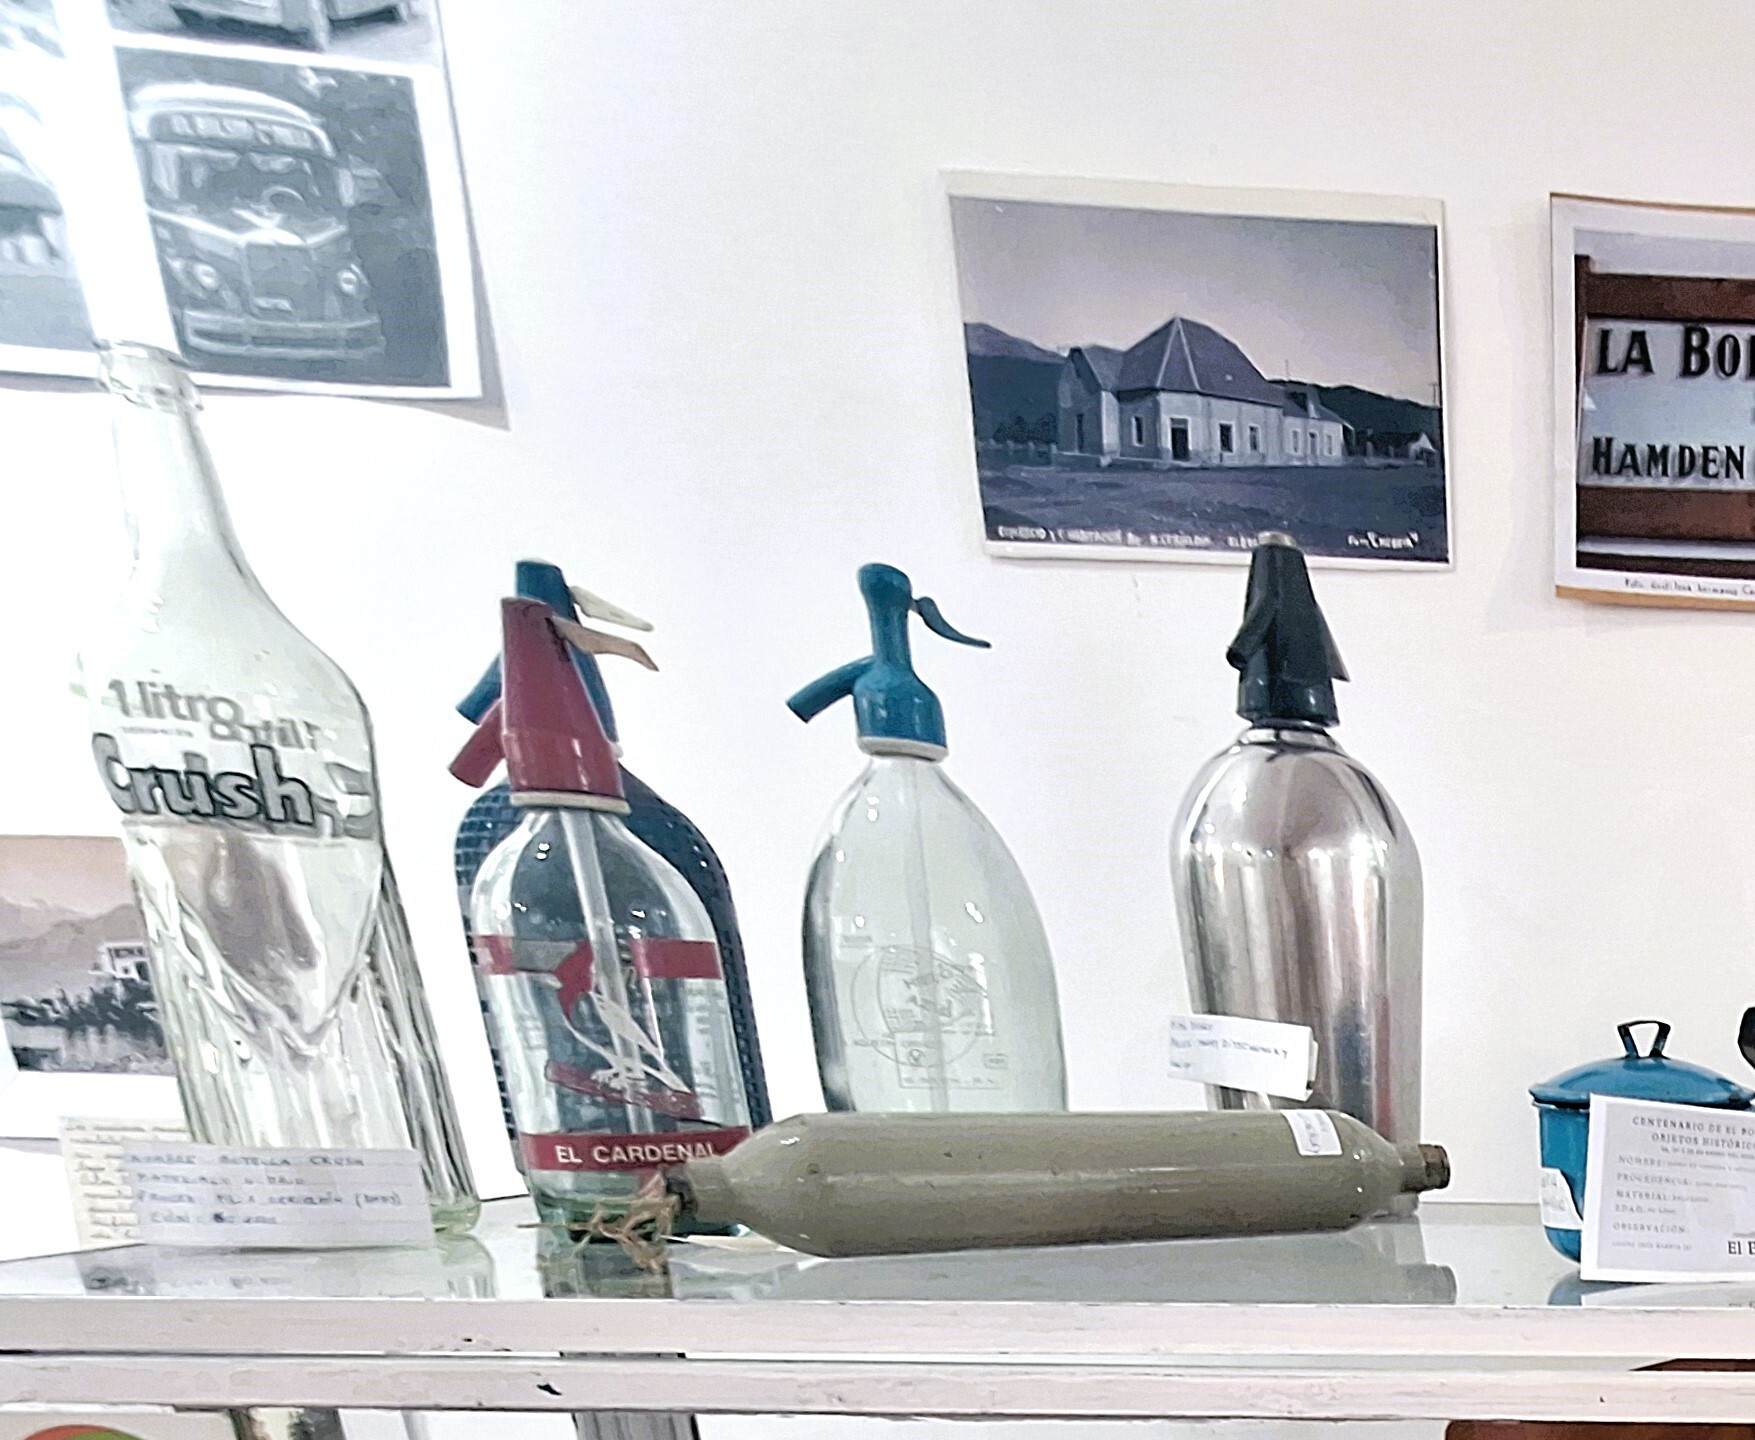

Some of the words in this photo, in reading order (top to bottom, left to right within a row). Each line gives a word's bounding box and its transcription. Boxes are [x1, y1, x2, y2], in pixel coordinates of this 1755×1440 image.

[1596, 328, 1654, 376] LA
[1592, 436, 1744, 480] HAMDEN
[92, 731, 315, 826] Crush
[1632, 1116, 1704, 1132] CENTENARIO
[1709, 1124, 1721, 1133] DE
[1726, 1126, 1737, 1135] EL
[1651, 1132, 1698, 1145] OBJETOS
[556, 1145, 582, 1163] EL
[593, 1143, 719, 1163] CARDENAL
[1727, 1240, 1742, 1255] El
